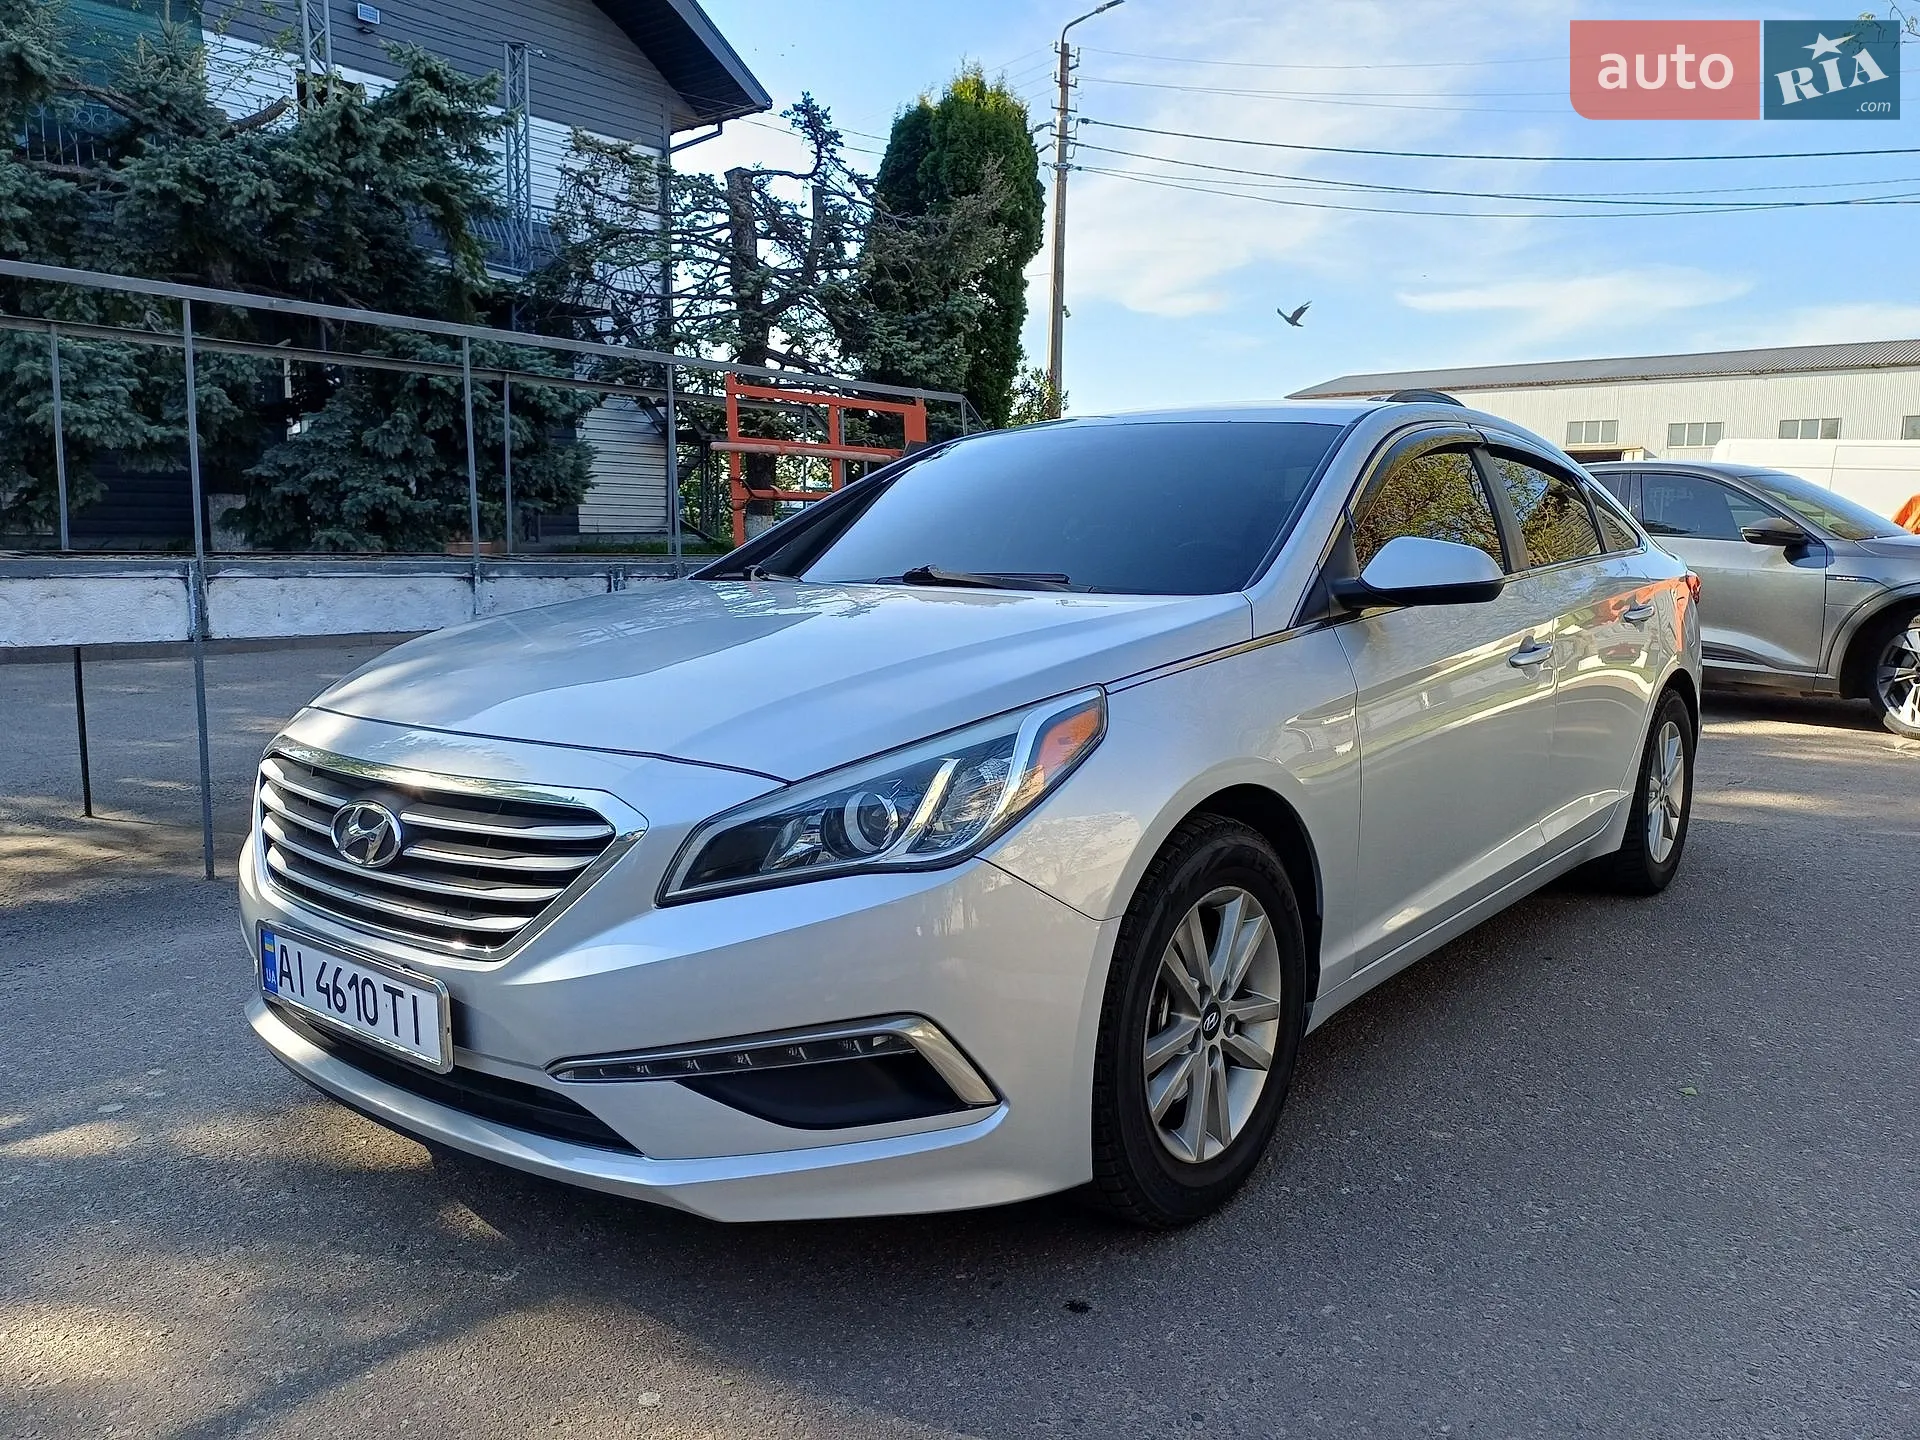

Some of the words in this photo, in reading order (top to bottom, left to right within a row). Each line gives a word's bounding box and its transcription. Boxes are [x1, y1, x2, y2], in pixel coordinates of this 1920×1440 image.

[266, 967, 276, 985] UA
[278, 943, 305, 998] AI
[315, 961, 379, 1027] 4610
[382, 983, 420, 1046] TI
